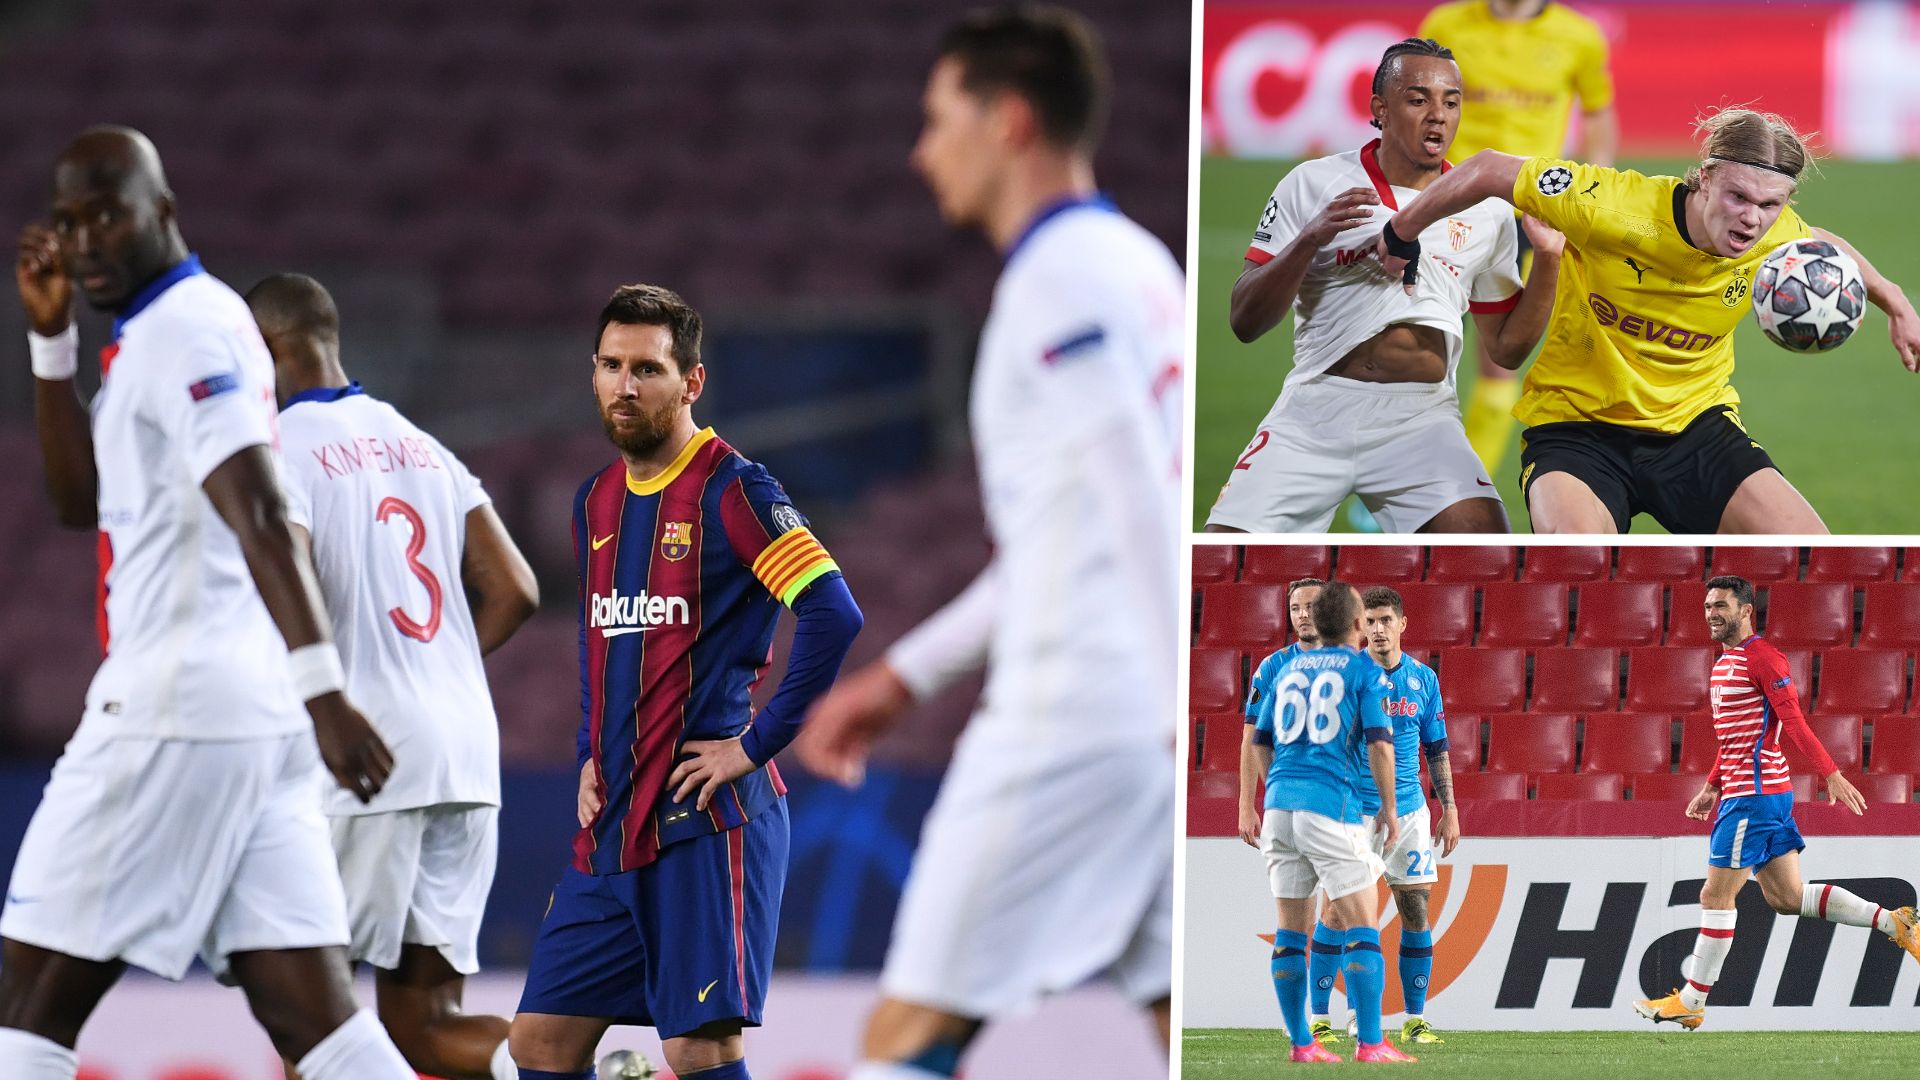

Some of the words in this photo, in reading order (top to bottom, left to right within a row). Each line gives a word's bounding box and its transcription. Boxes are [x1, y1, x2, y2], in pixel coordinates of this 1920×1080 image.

[1725, 280, 1747, 298] BVB
[1620, 315, 1724, 352] EVONI
[1234, 430, 1270, 470] 2
[376, 497, 442, 643] 3
[590, 588, 690, 628] Rakuten
[1290, 655, 1350, 671] LOBOTKA
[1273, 671, 1345, 745] 68
[1406, 850, 1434, 876] 22
[1494, 877, 1920, 1009] Han
